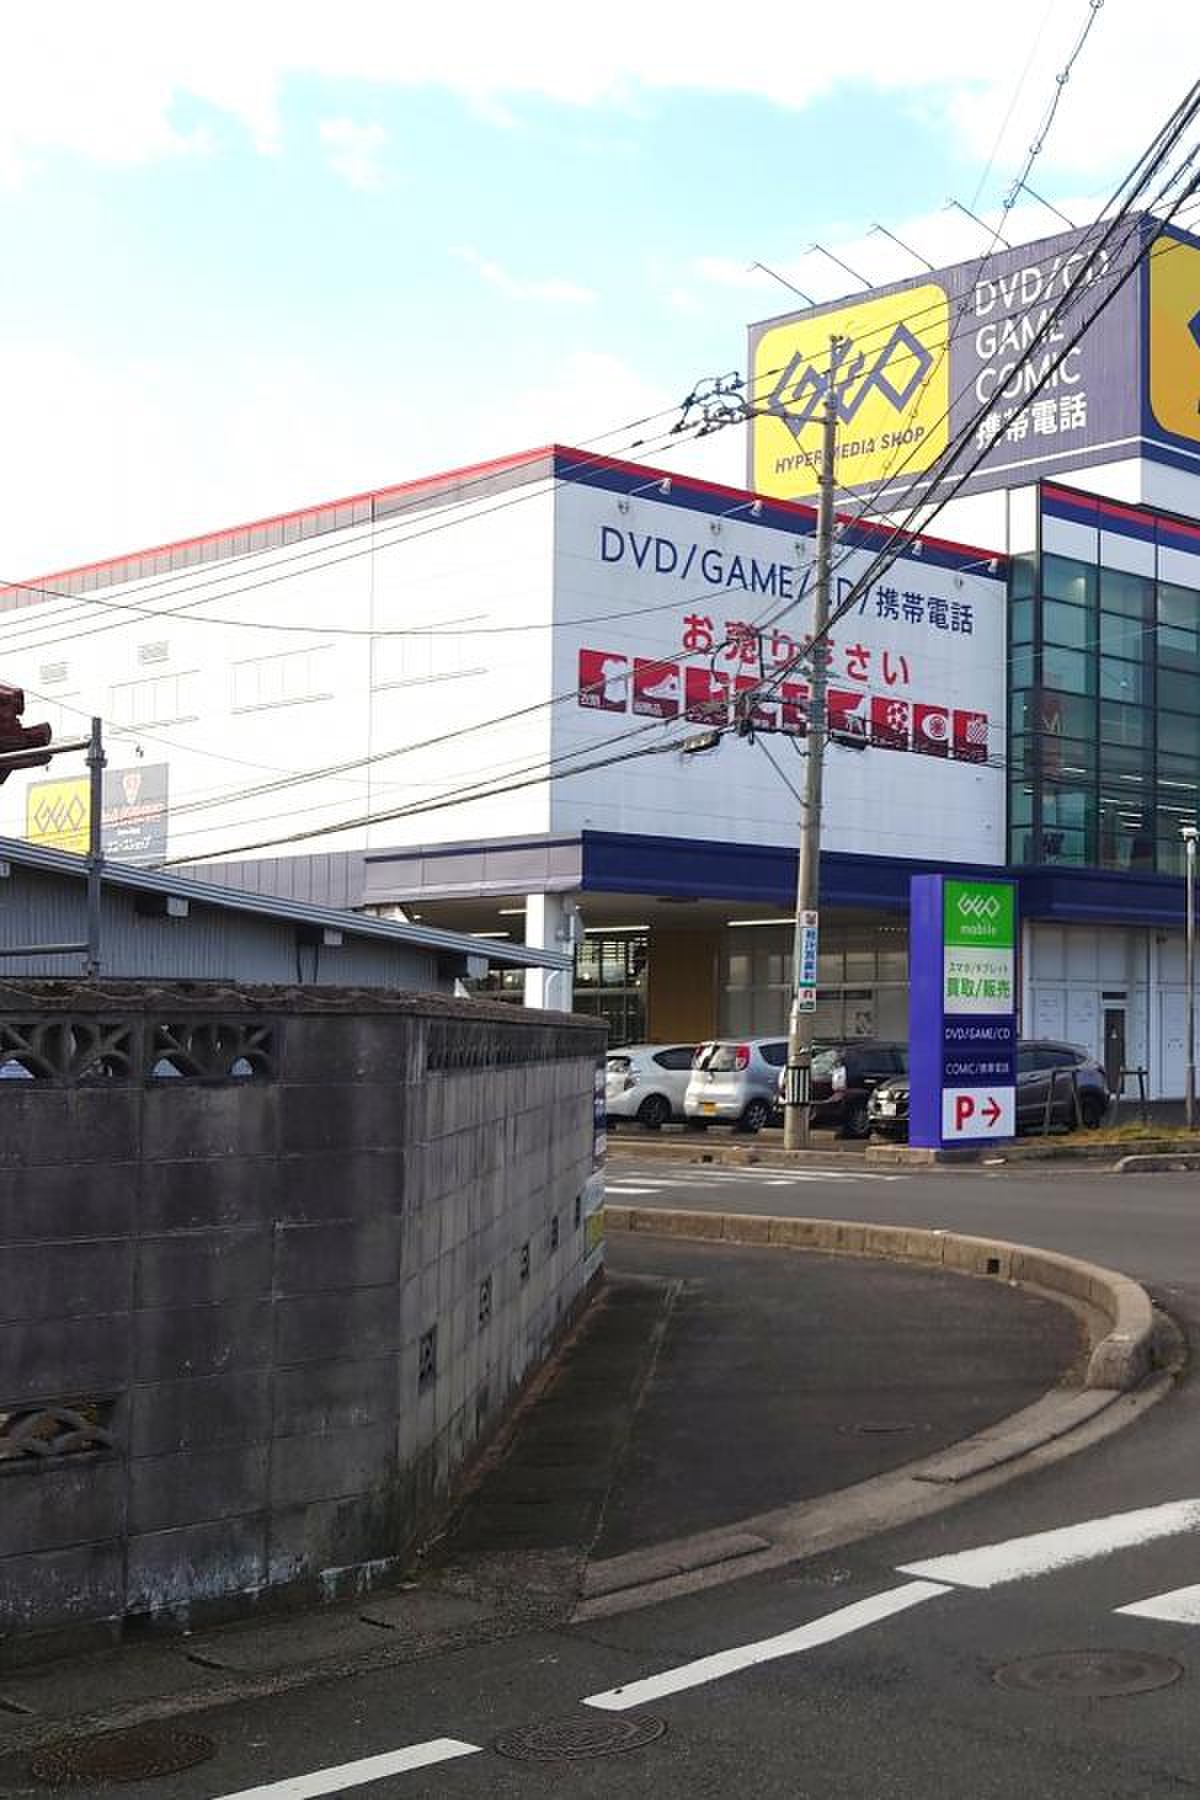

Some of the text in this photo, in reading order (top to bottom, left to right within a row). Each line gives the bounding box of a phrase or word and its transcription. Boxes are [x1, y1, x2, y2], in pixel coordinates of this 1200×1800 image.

[975, 305, 1064, 360] GAME
[975, 347, 1081, 404] COMIC
[830, 438, 875, 461] EDIA
[880, 426, 925, 450] SHOP
[600, 526, 975, 636] DVD/GAME/D/携帯電話
[960, 923, 997, 936] mobile
[956, 1095, 976, 1131] P
